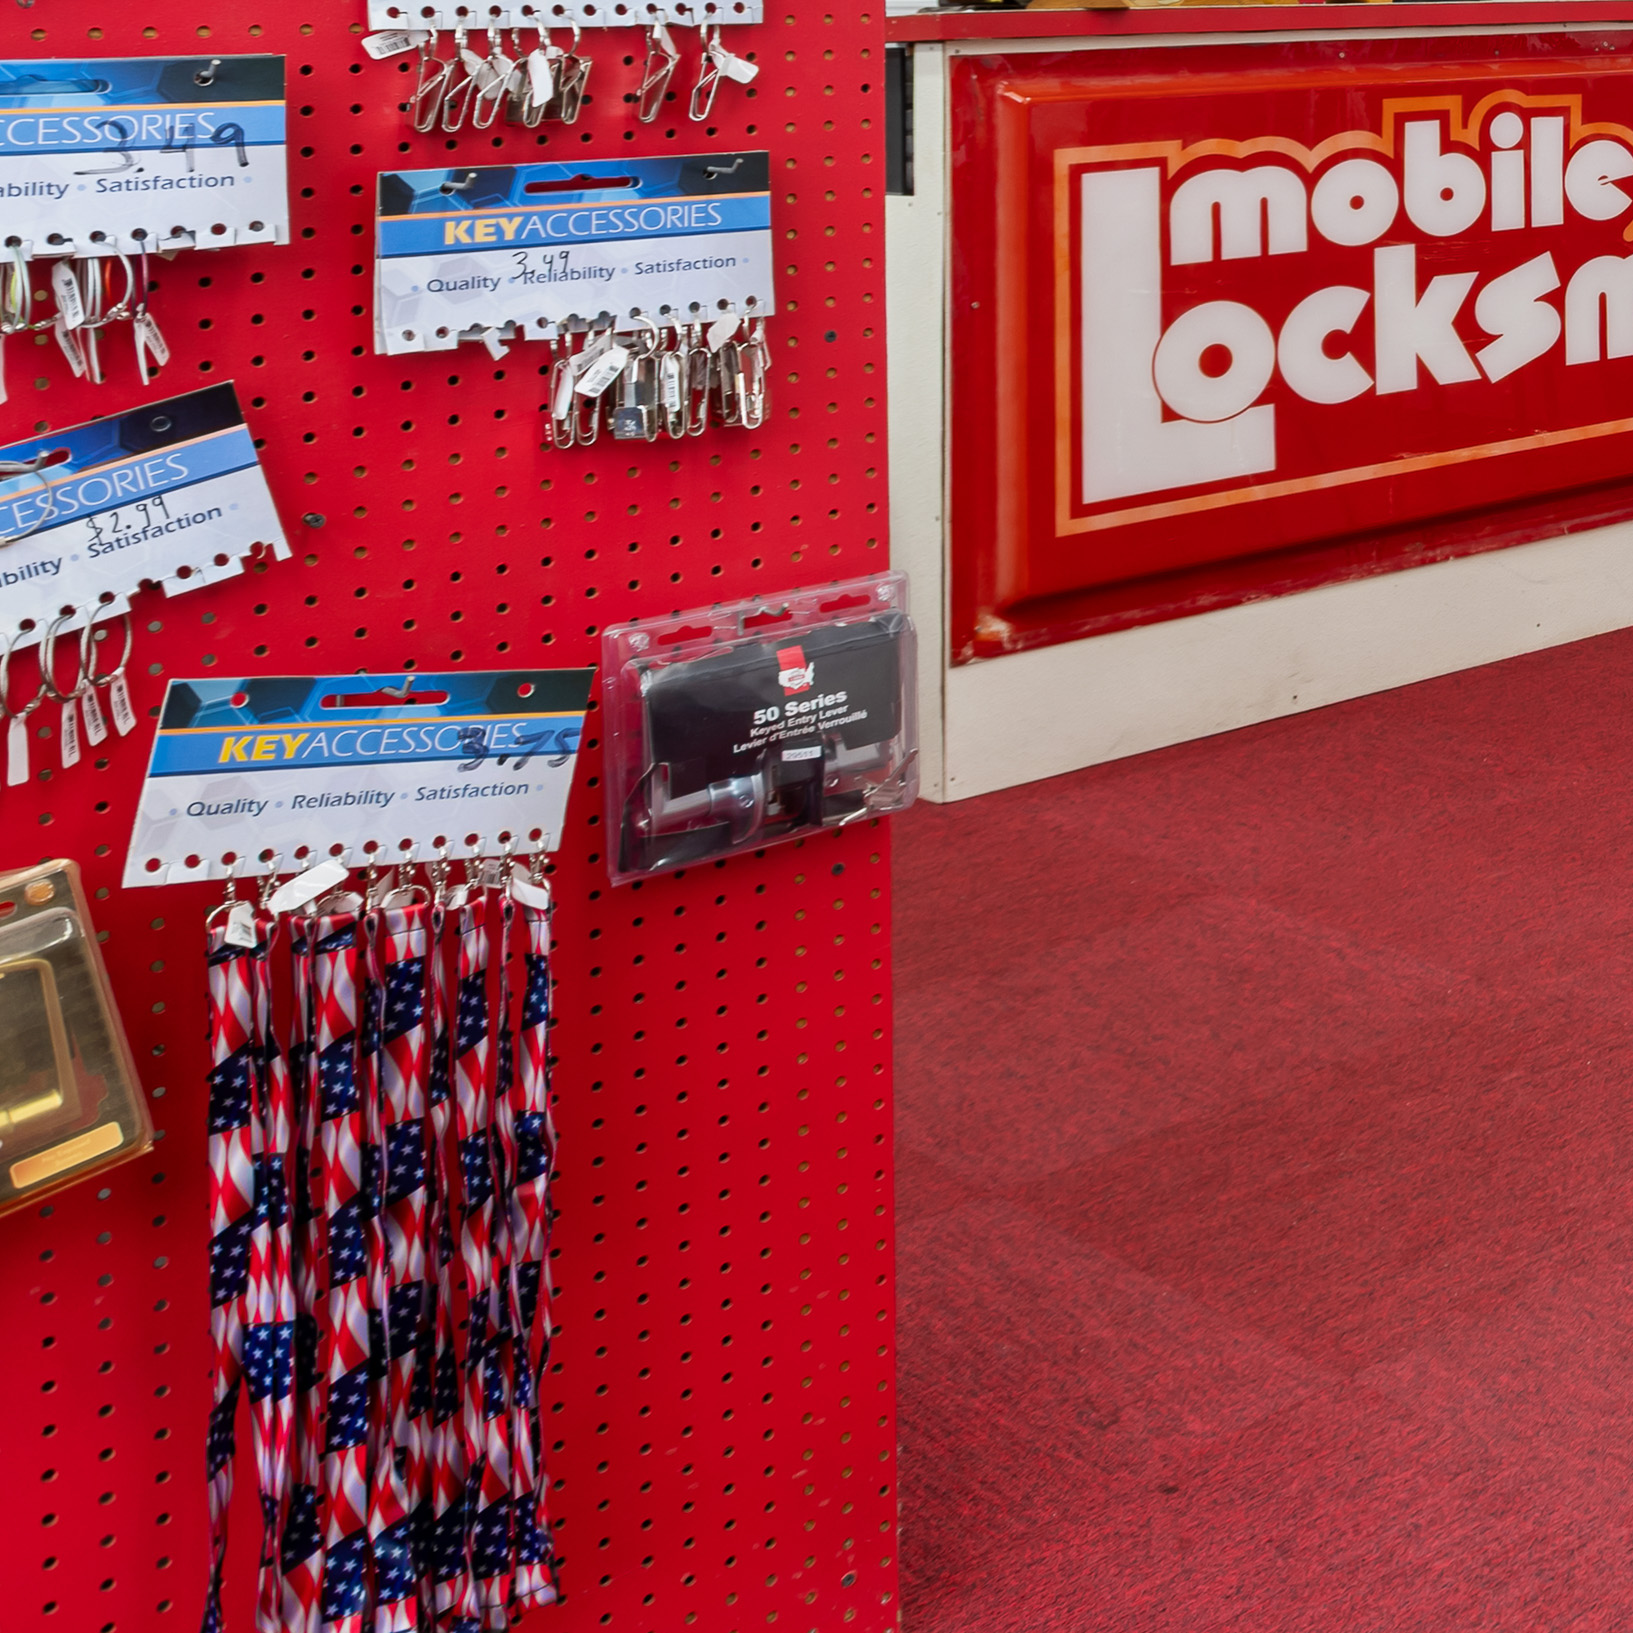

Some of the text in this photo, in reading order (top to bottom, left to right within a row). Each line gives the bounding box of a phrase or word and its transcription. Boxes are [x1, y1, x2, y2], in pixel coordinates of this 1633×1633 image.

[73, 119, 250, 177] 3.49
[95, 173, 236, 194] Satisfaction
[426, 254, 738, 294] Quality Reliability Satisfaction
[511, 250, 571, 280] 3.49
[85, 494, 171, 546] $2.99
[87, 505, 223, 559] Satisfaction
[750, 704, 849, 738] Keyed Entry Lever
[753, 690, 849, 725] 50 Series
[457, 726, 581, 772] 3.75
[732, 736, 768, 754] Levier
[817, 709, 868, 731] Verrouillé
[186, 780, 530, 818] Quality Reliability Satisfaction
